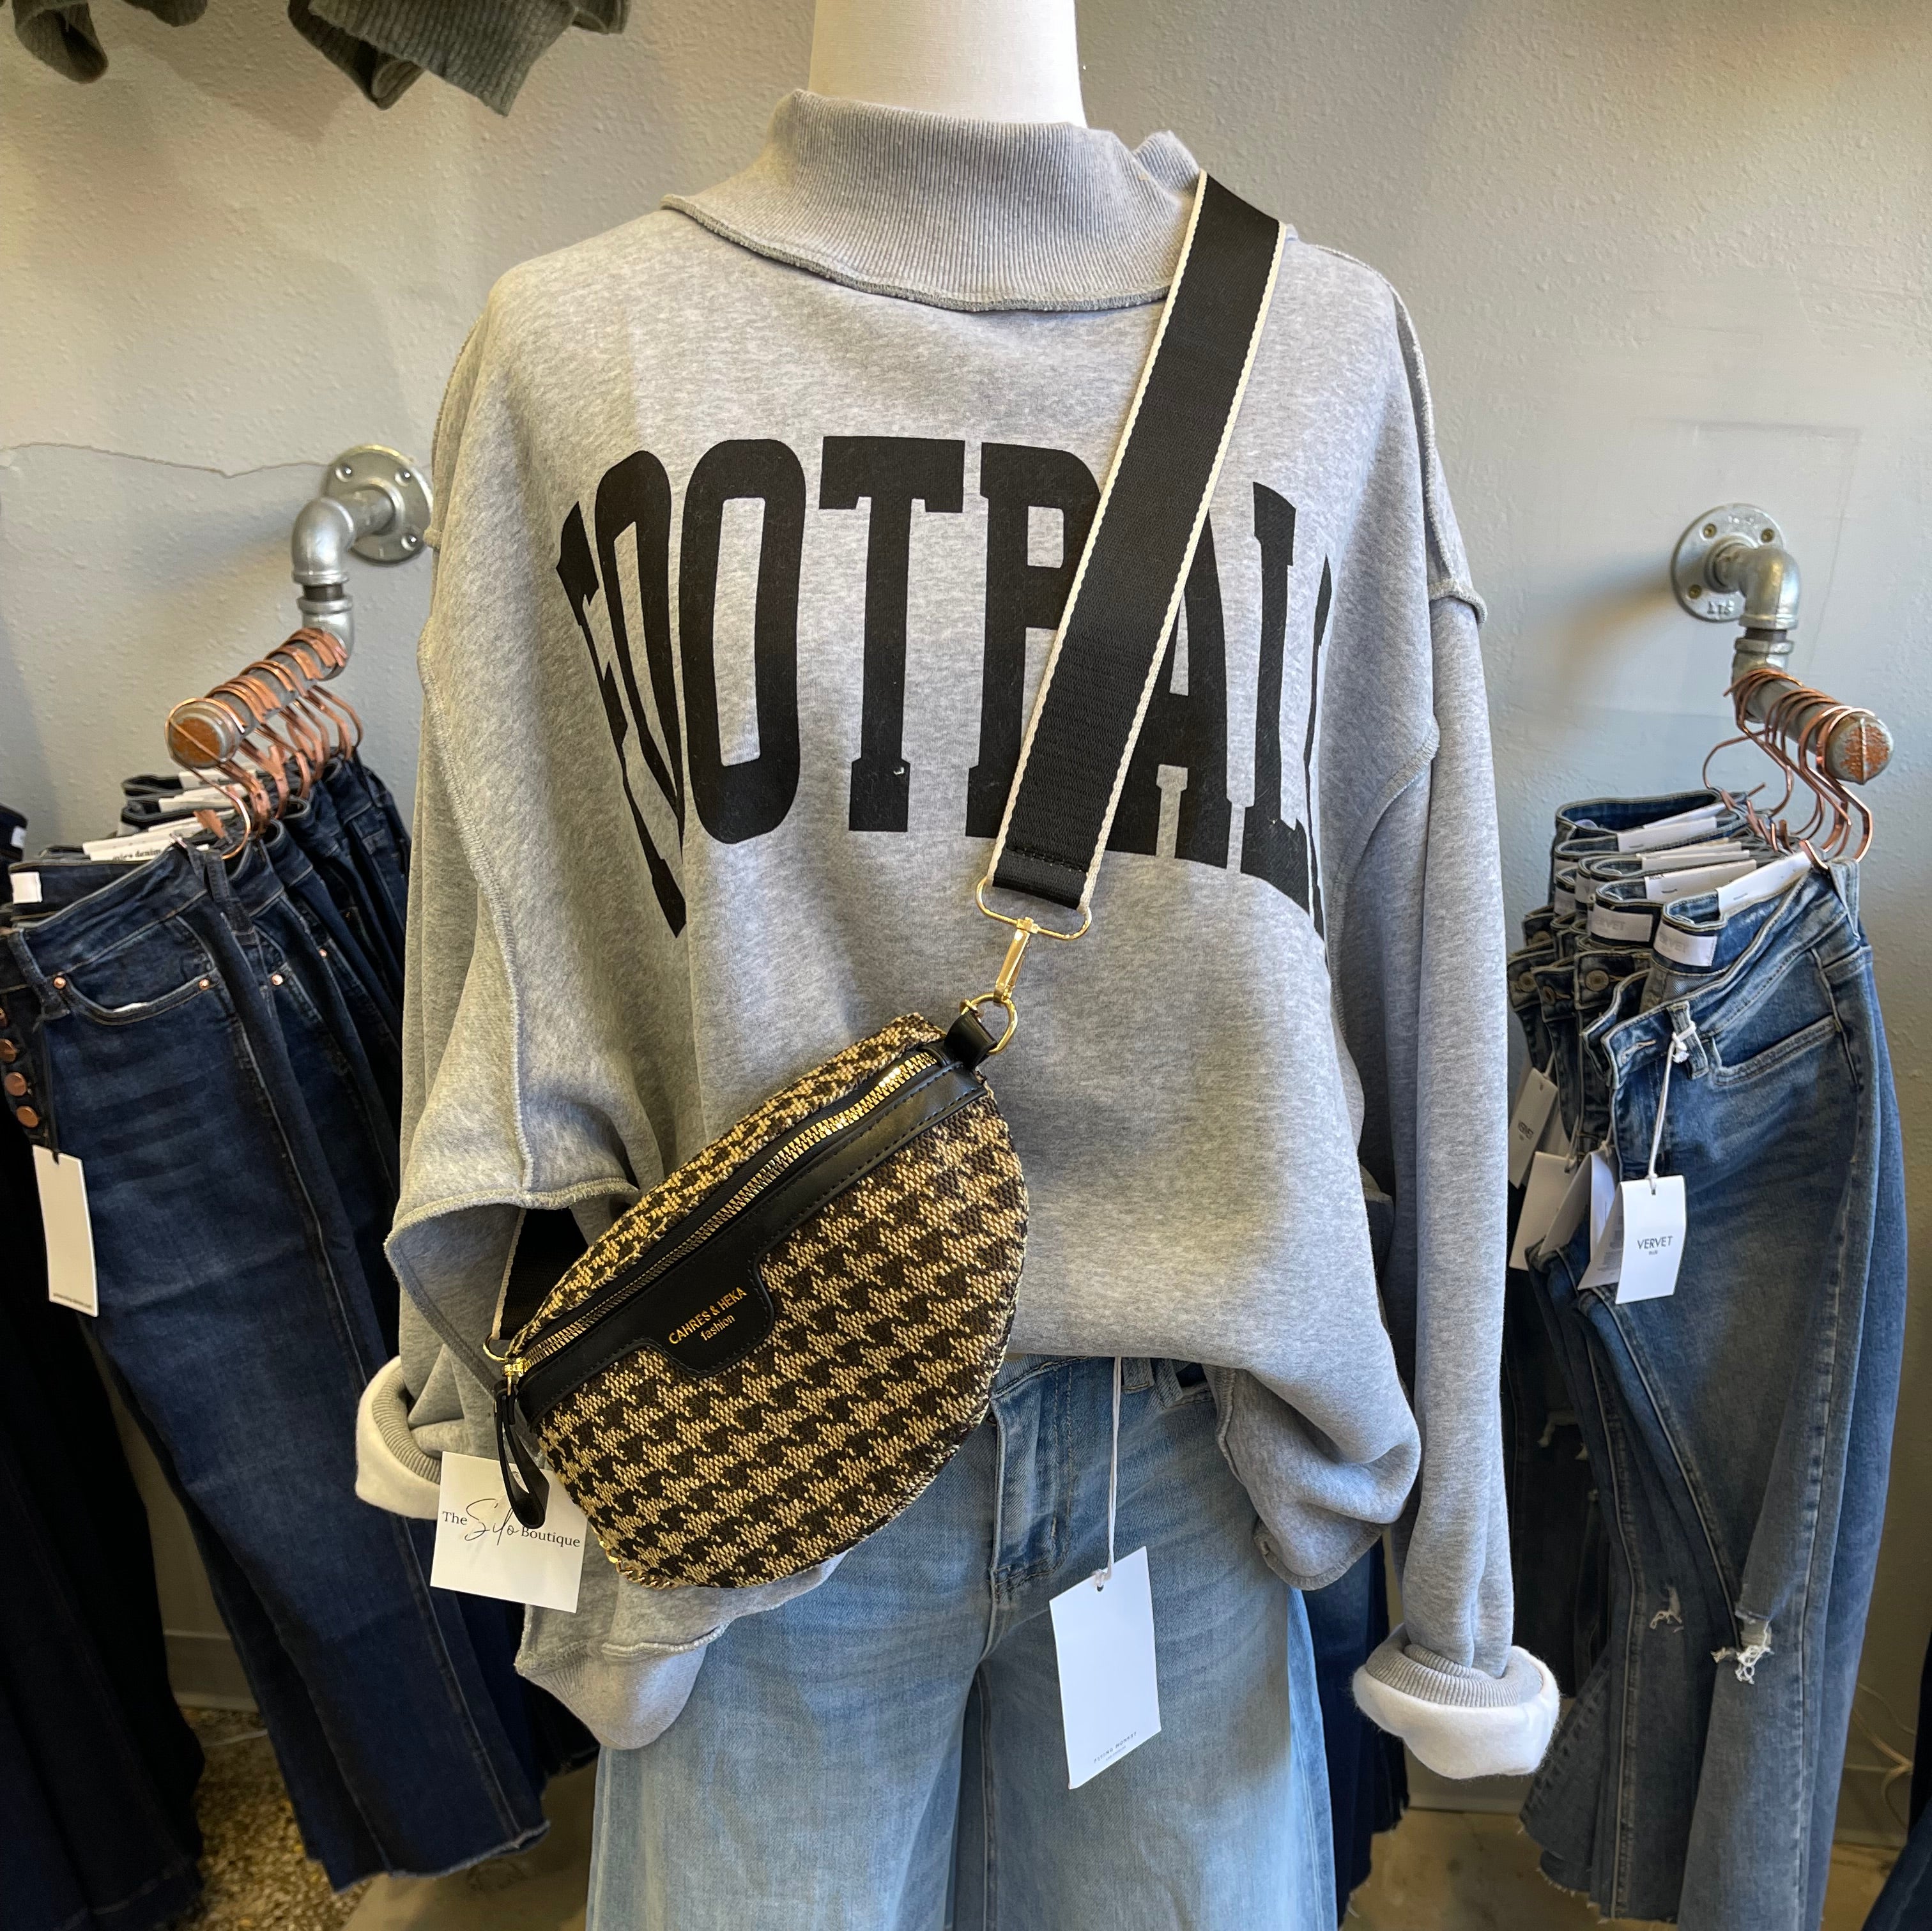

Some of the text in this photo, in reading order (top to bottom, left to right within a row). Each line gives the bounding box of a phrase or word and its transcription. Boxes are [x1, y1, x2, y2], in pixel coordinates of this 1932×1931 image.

[1637, 1235, 1673, 1249] VERVET
[668, 1286, 747, 1344] CAHRES & HEKA
[700, 1315, 735, 1341] fashion
[442, 1511, 468, 1525] The
[521, 1525, 581, 1548] Boutique
